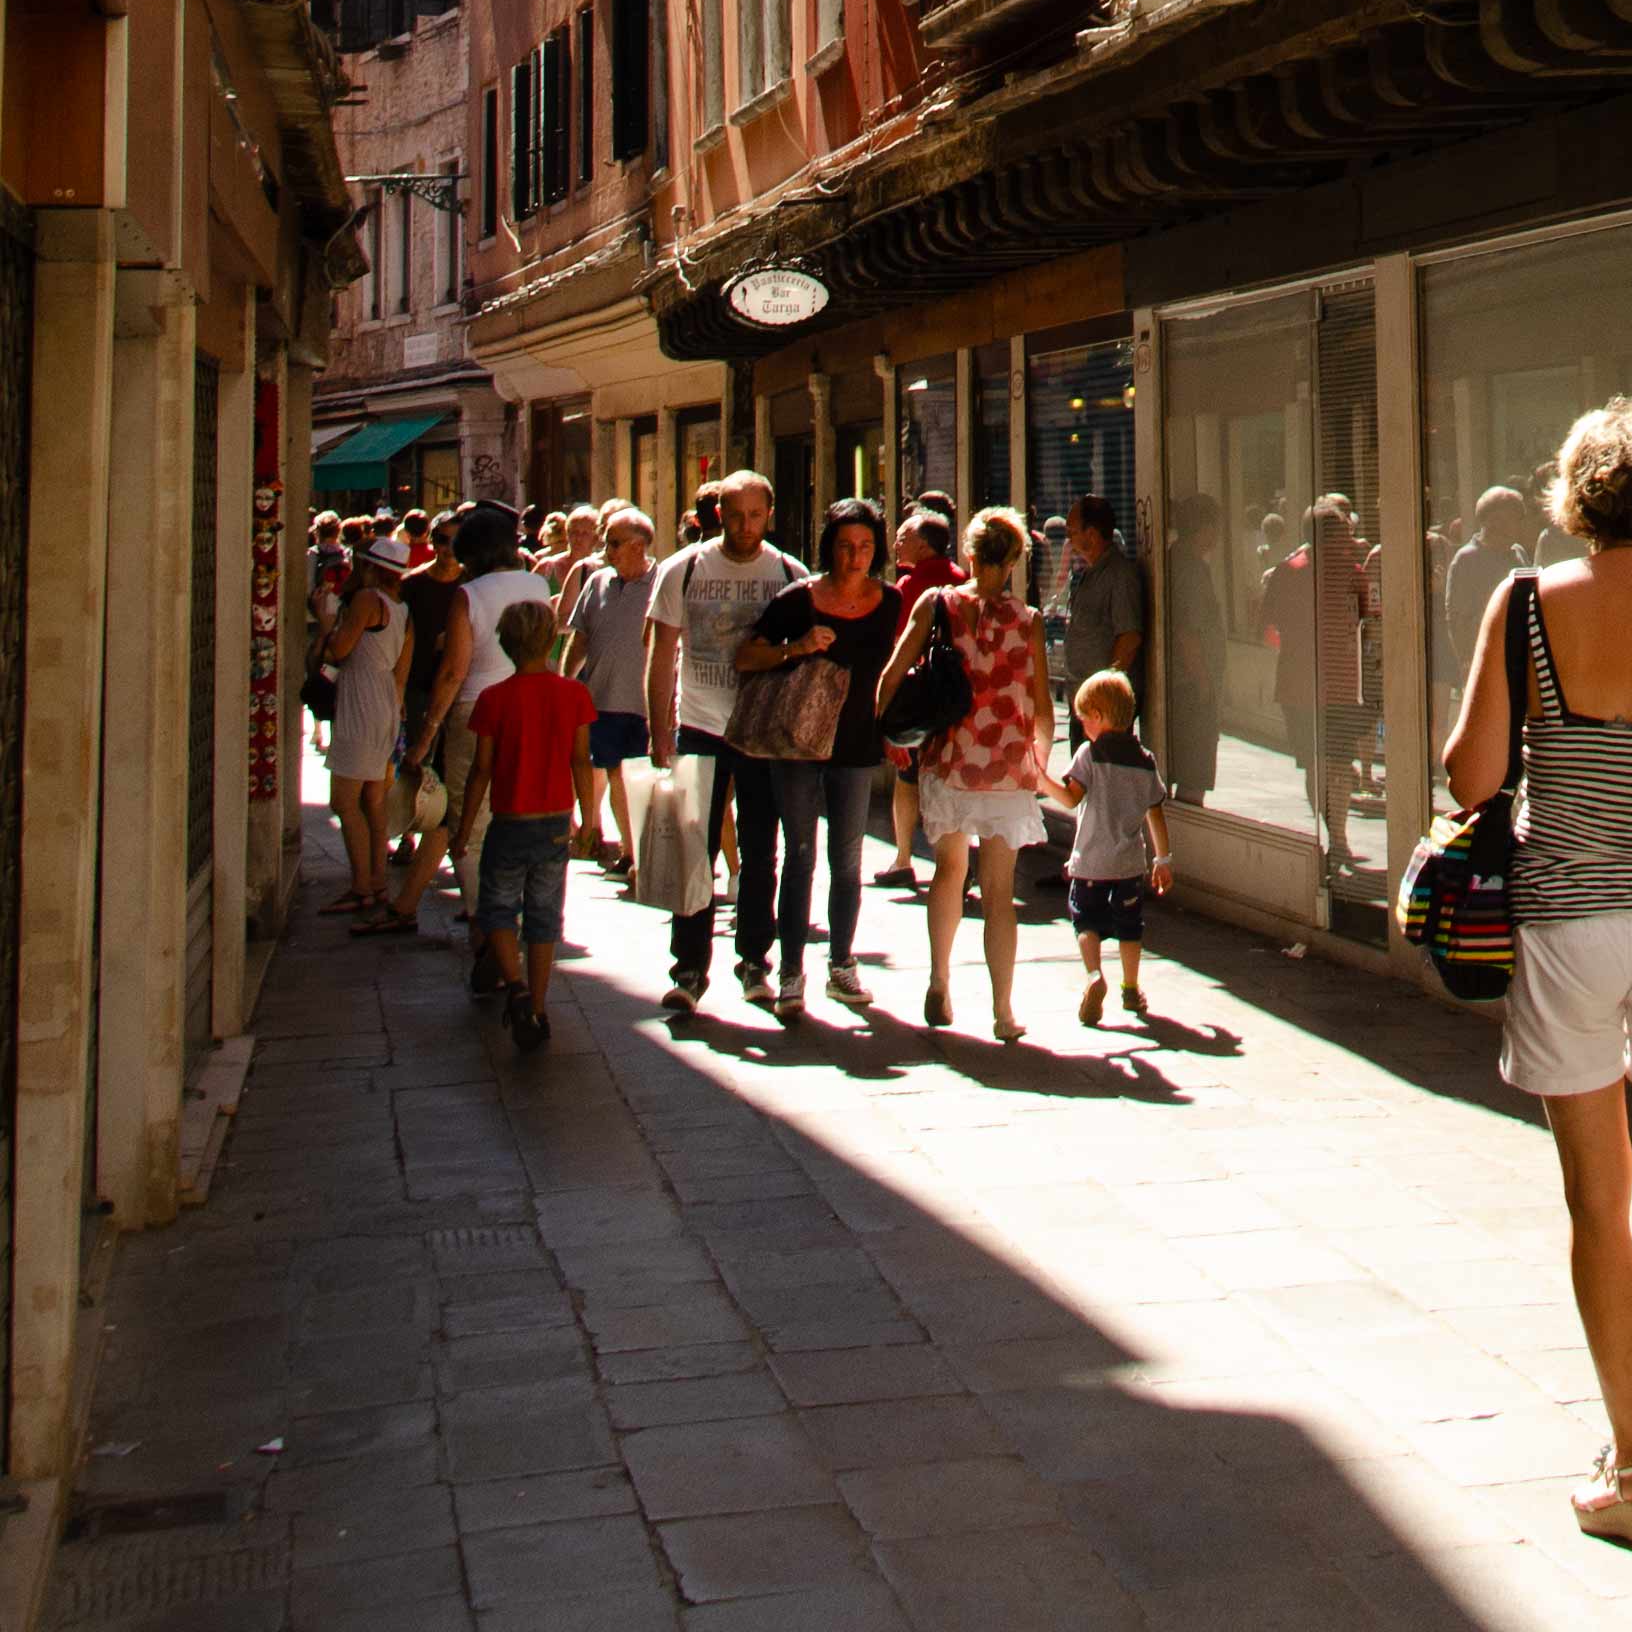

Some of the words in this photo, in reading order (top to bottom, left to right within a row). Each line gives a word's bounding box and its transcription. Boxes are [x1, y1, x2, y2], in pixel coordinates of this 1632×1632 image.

[771, 286, 791, 298] Bar
[688, 579, 731, 601] WHERE
[735, 579, 758, 601] THE
